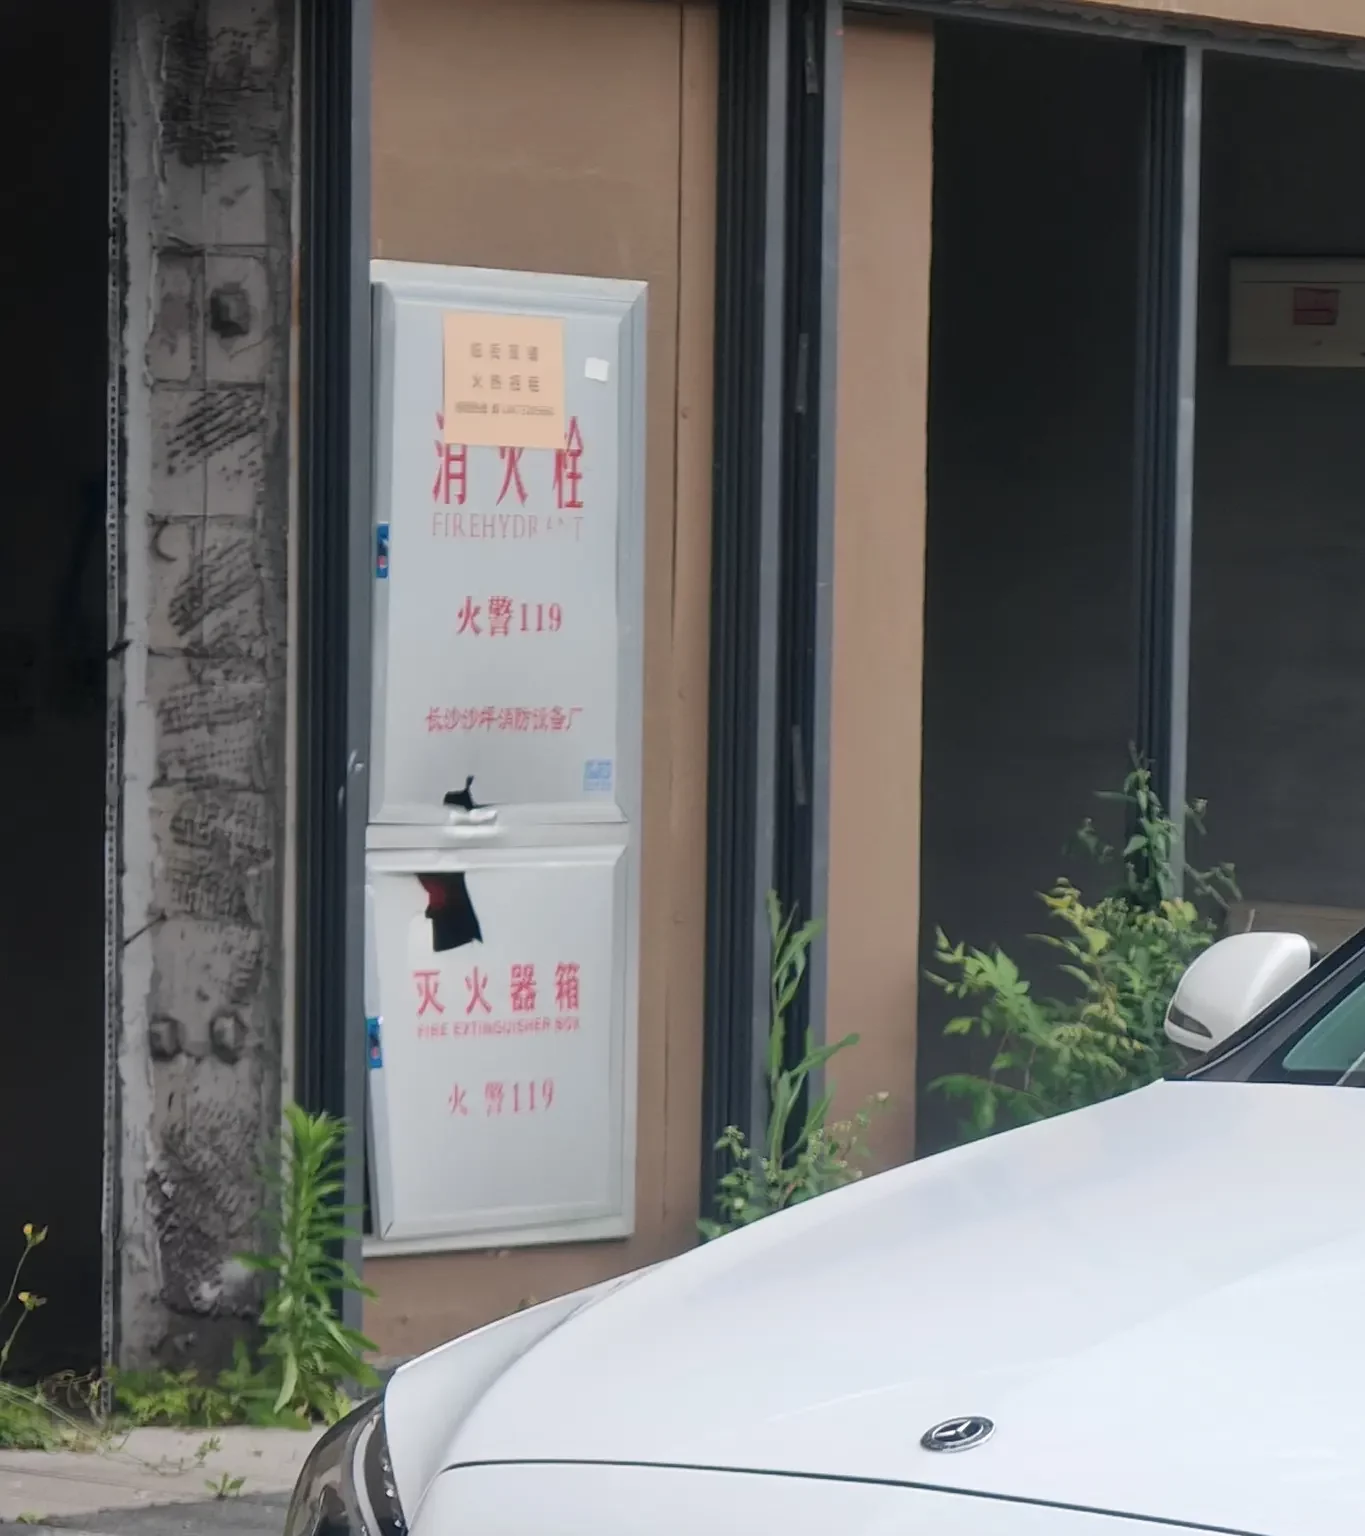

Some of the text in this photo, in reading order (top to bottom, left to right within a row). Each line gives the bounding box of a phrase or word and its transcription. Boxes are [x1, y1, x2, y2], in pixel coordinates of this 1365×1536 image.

[456, 596, 562, 637] 火警119
[413, 962, 580, 1016] 灭火器箱
